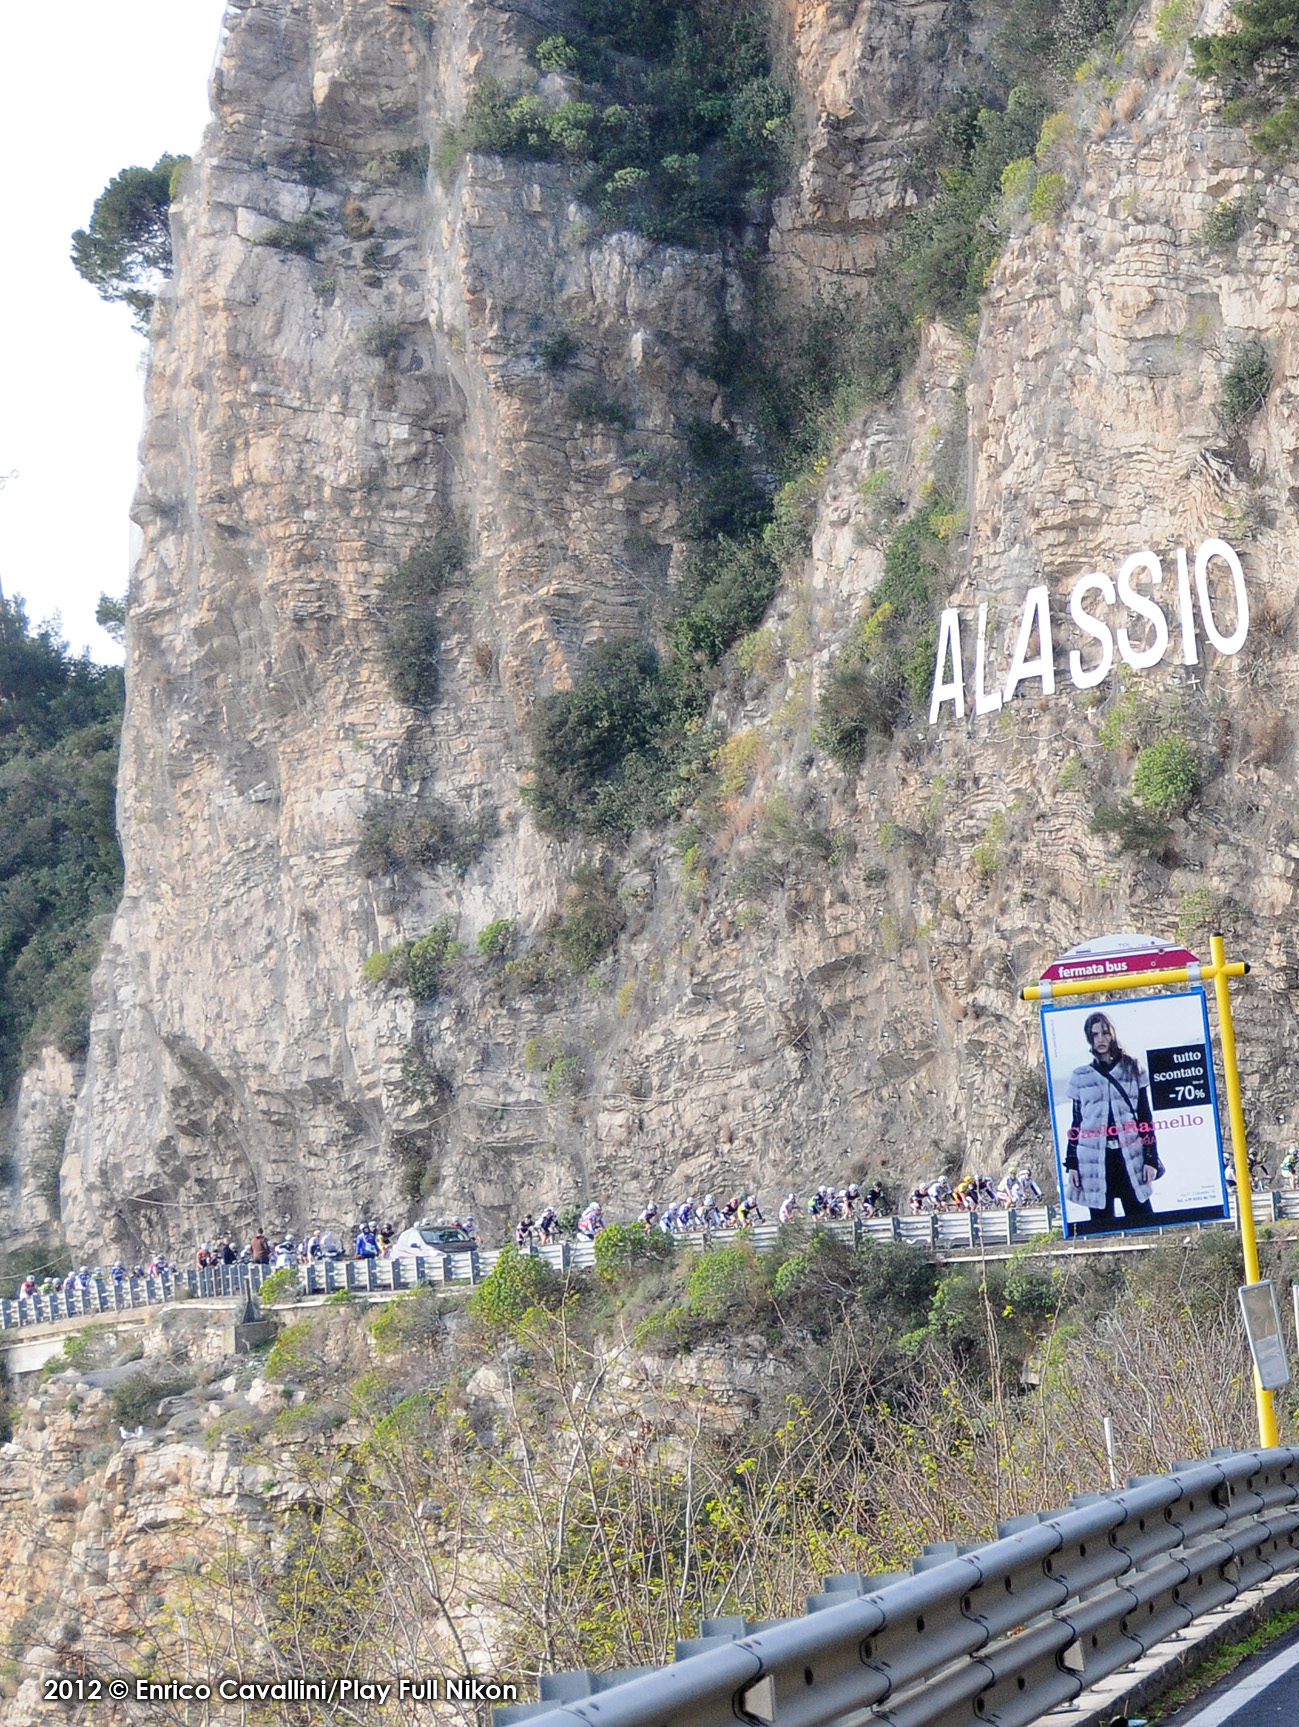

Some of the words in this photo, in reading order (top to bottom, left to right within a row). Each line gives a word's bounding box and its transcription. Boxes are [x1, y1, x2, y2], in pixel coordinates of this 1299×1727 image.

[929, 538, 1250, 724] ALASSIO
[1058, 963, 1104, 978] fermata
[1105, 961, 1128, 973] bus
[1173, 1051, 1202, 1064] tutto
[1153, 1066, 1204, 1082] scontato
[1169, 1085, 1206, 1101] -70%
[1067, 1124, 1119, 1141] Carlo
[1124, 1114, 1204, 1134] Ramello
